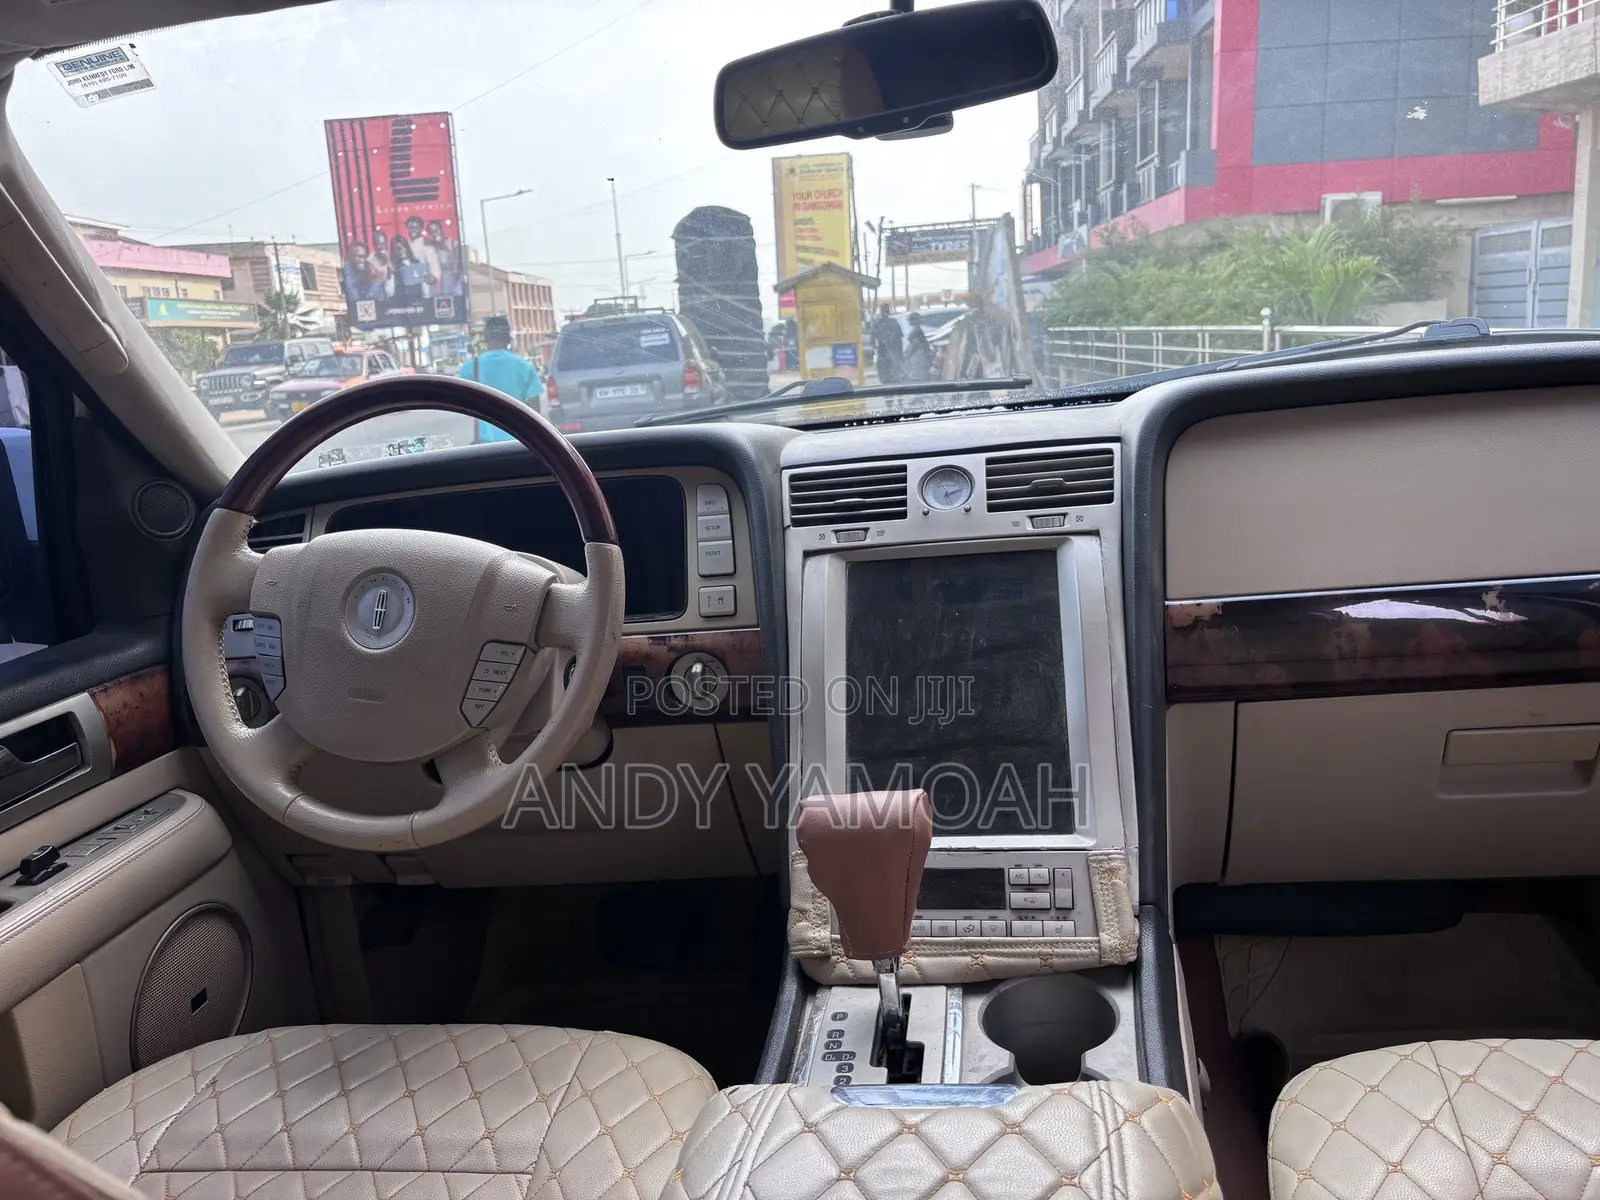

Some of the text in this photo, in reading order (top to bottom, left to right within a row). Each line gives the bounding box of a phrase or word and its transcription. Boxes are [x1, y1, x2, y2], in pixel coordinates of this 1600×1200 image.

[62, 50, 122, 70] GENUINE
[67, 77, 83, 86] JOHN
[81, 70, 109, 82] KENNEDY
[108, 66, 124, 76] FORD
[792, 189, 843, 201] YOUR CHURCH
[353, 575, 411, 605] LINCOLN
[841, 1065, 849, 1073] 3
[839, 1077, 847, 1085] 2
